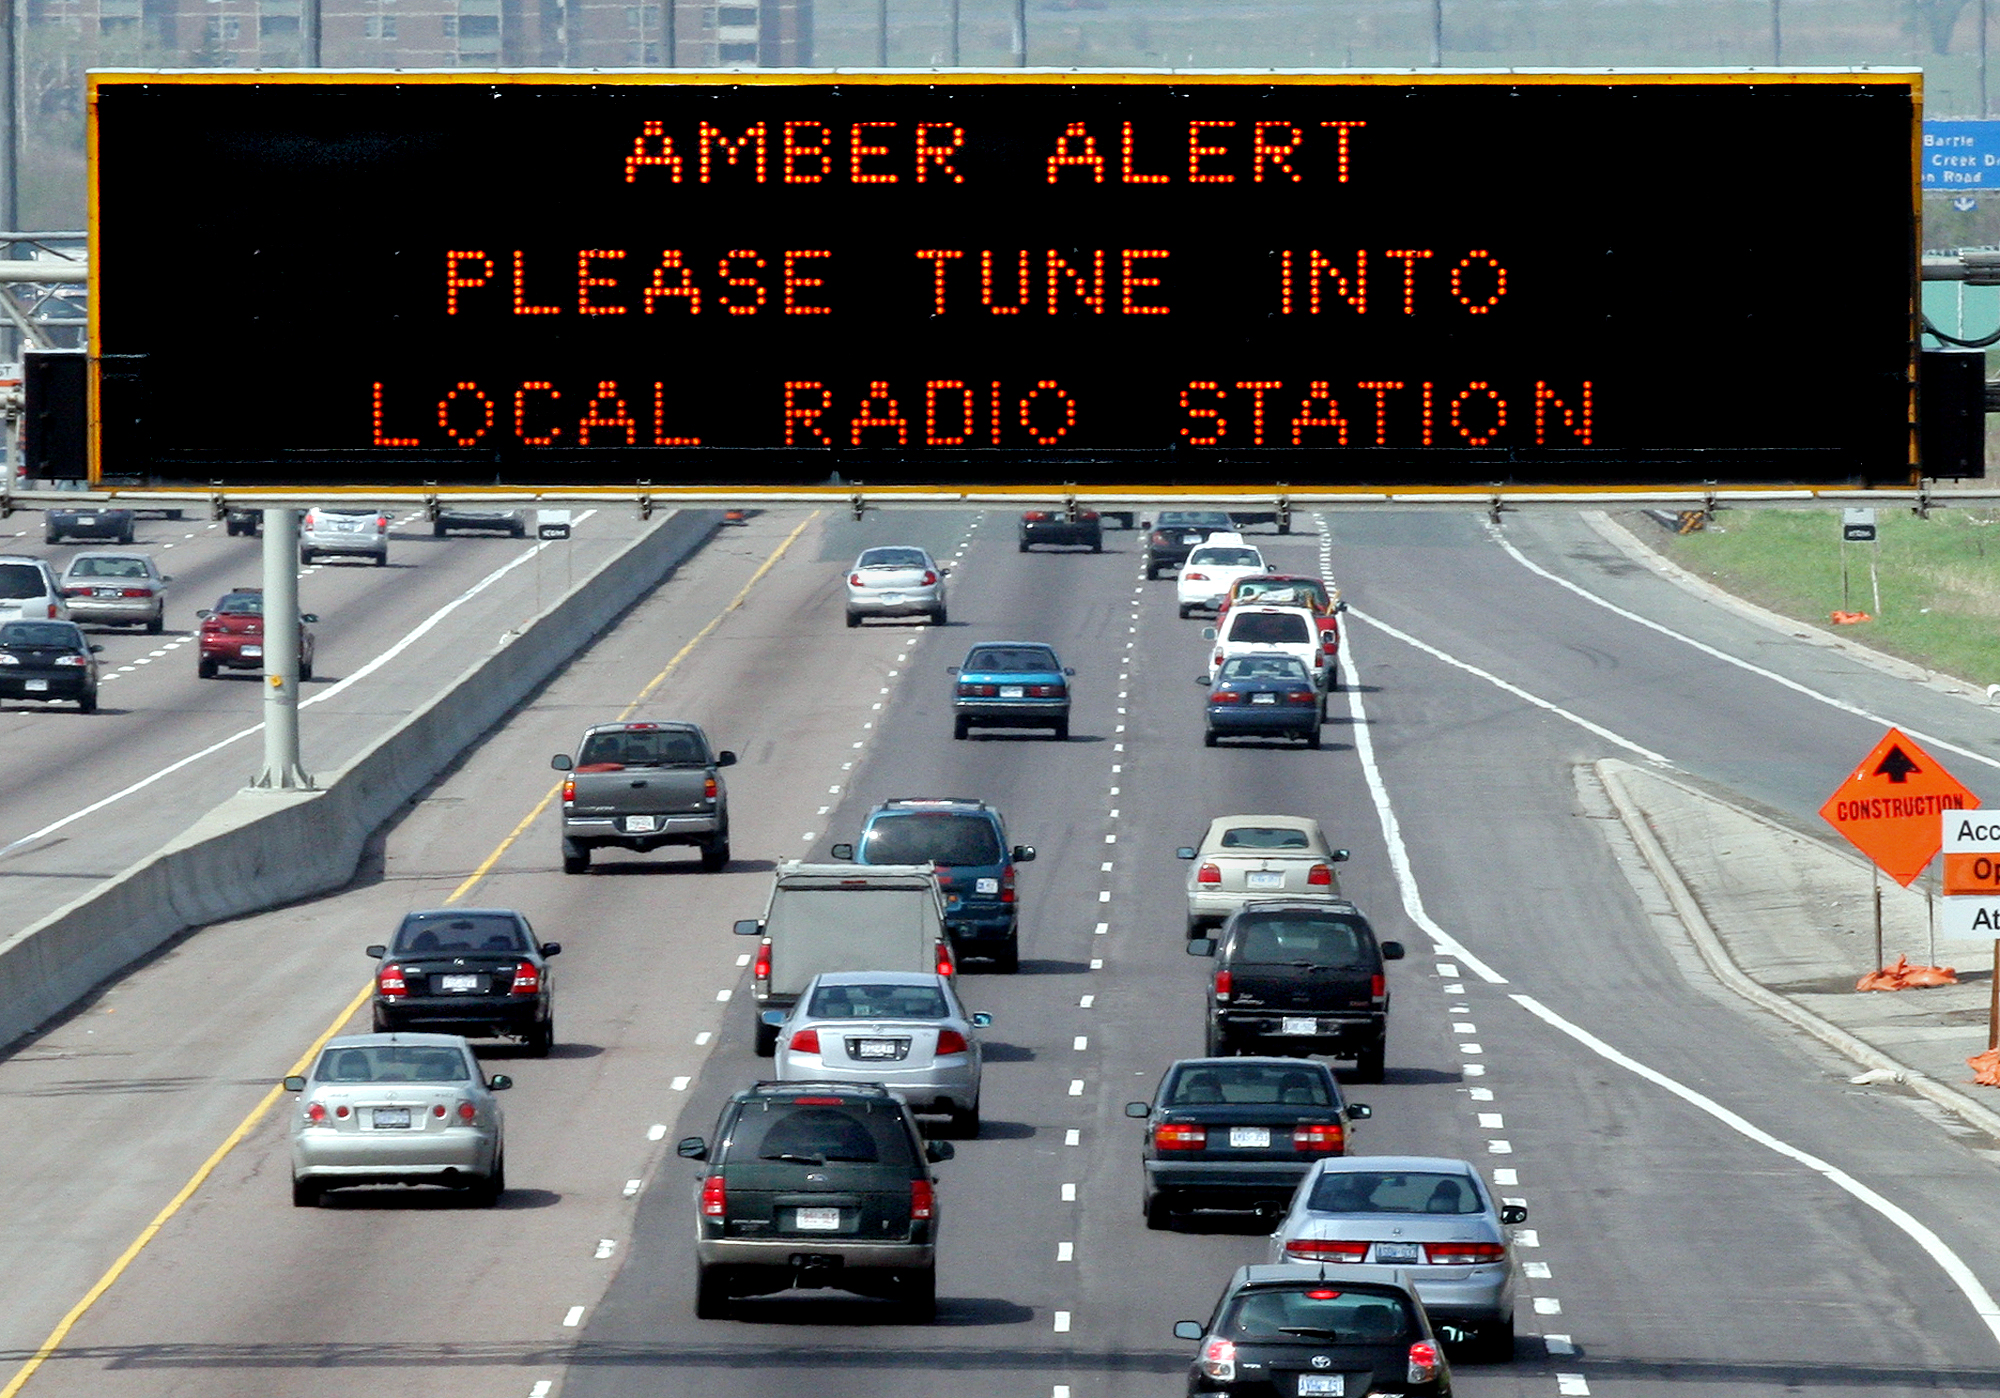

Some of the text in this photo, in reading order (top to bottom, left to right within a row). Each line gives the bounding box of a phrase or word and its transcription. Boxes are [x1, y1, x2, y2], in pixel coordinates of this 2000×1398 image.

[624, 119, 1367, 185] AMBER ALERT
[1943, 170, 1983, 183] Road
[446, 248, 1508, 316] PLEASE TUNE INTO
[371, 379, 1593, 447] LOCAL RADIO STATION
[1836, 793, 1963, 822] CONSTRUCTION
[1957, 819, 2000, 842] Acc
